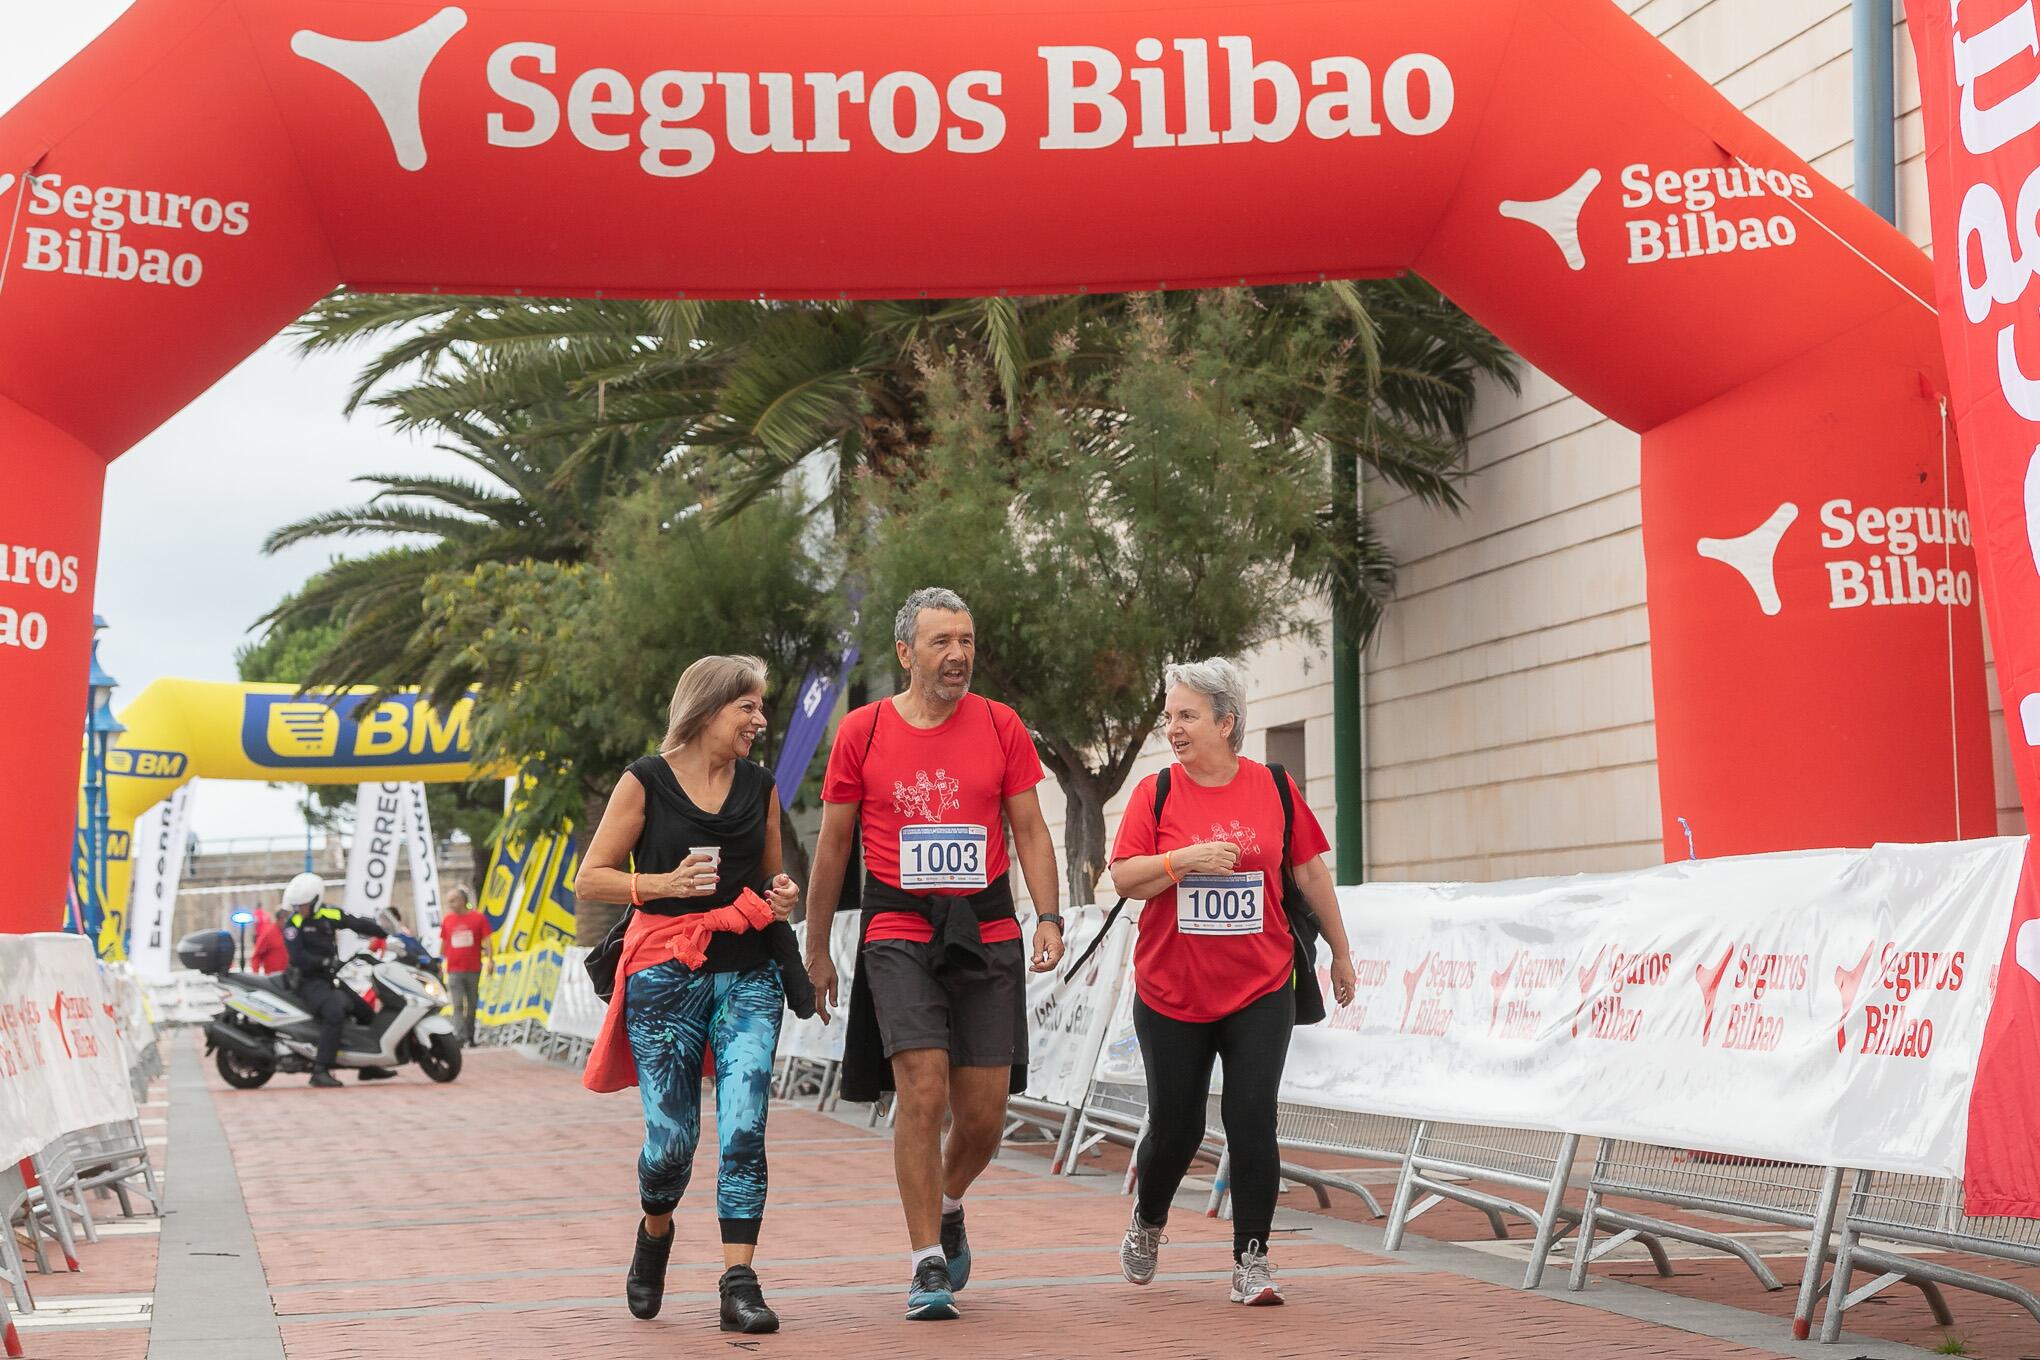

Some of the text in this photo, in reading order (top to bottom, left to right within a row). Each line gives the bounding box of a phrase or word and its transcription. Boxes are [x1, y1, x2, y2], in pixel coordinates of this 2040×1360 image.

[486, 35, 1455, 178] Seguros Bilbao
[28, 173, 249, 236] Seguros
[1620, 163, 1814, 212] Seguros
[22, 227, 203, 287] Bilbao
[1625, 211, 1797, 264] Bilbao
[1820, 498, 1974, 555] Seguro
[1825, 555, 1972, 609] Bilbao
[353, 697, 476, 756] BM
[135, 753, 182, 776] BM
[912, 842, 978, 873] 1003
[1189, 889, 1255, 919] 1003
[1425, 951, 1478, 996] Seguros
[1734, 943, 1808, 1000] Seguros
[1872, 942, 1965, 1002] Seguros
[1721, 1002, 1784, 1052] Bilbao
[1860, 1005, 1933, 1058] Bilbao
